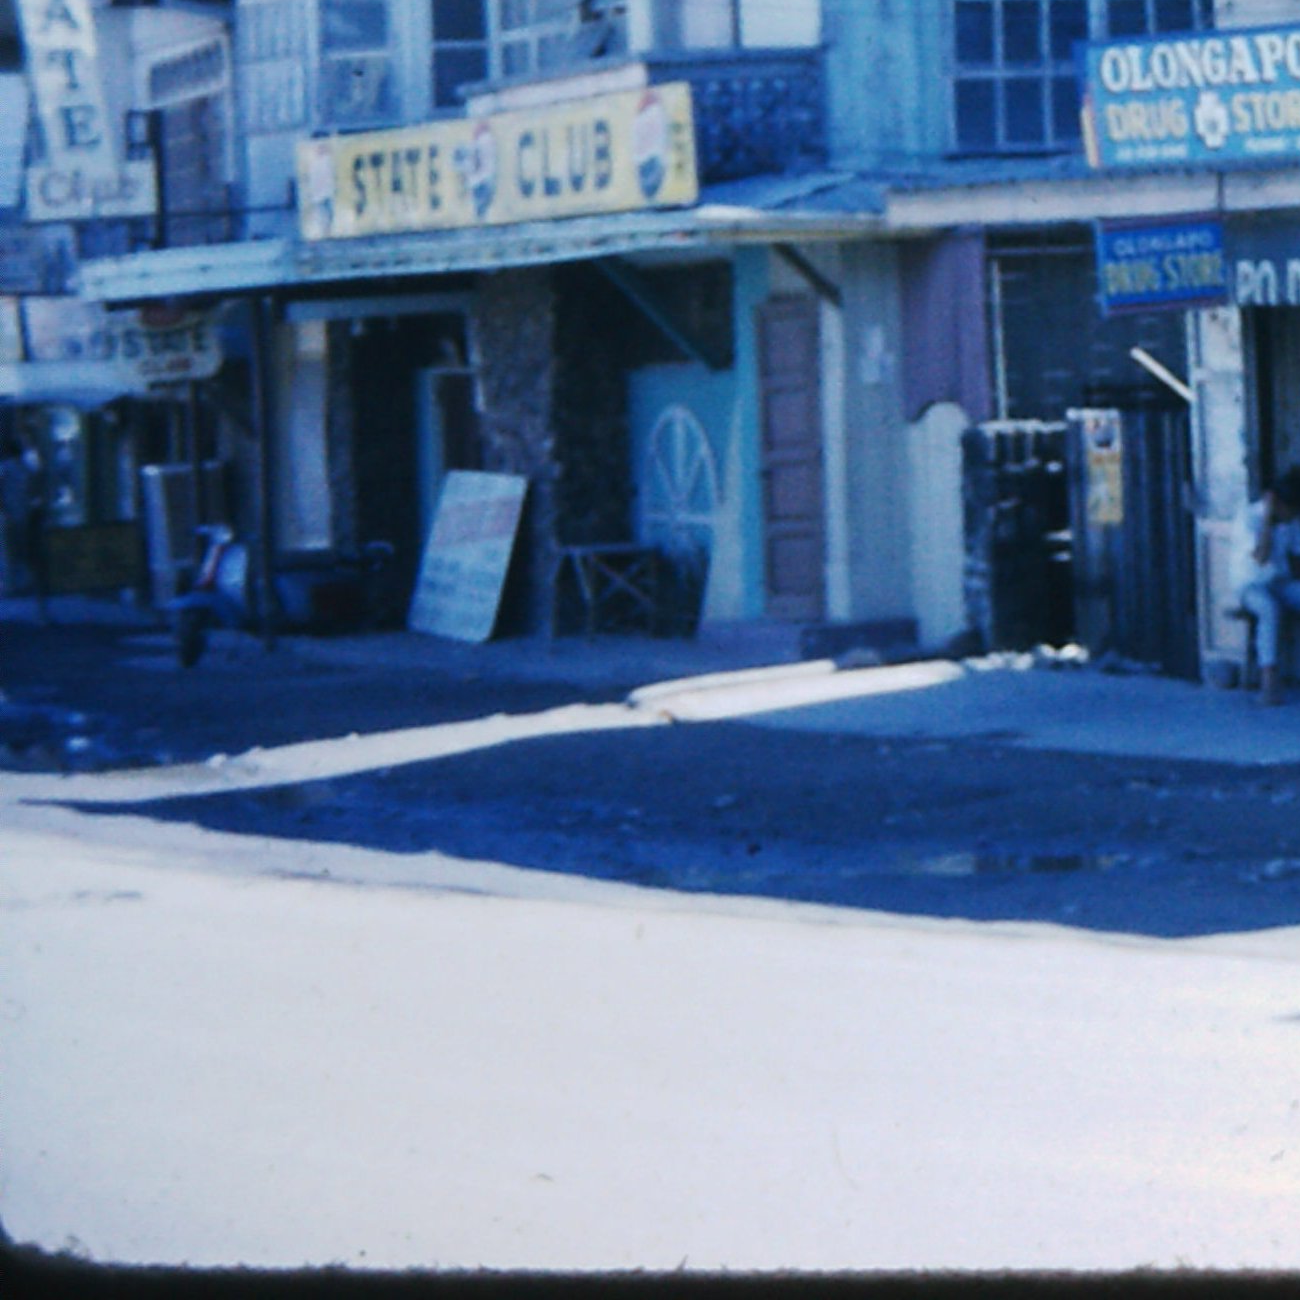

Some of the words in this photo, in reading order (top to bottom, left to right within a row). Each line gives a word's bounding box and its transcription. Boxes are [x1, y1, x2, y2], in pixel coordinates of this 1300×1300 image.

[1107, 98, 1189, 141] DRUG
[353, 144, 441, 216] STATE
[518, 120, 612, 198] CLUB
[1106, 259, 1160, 294] DRUG
[1164, 250, 1225, 289] STORE
